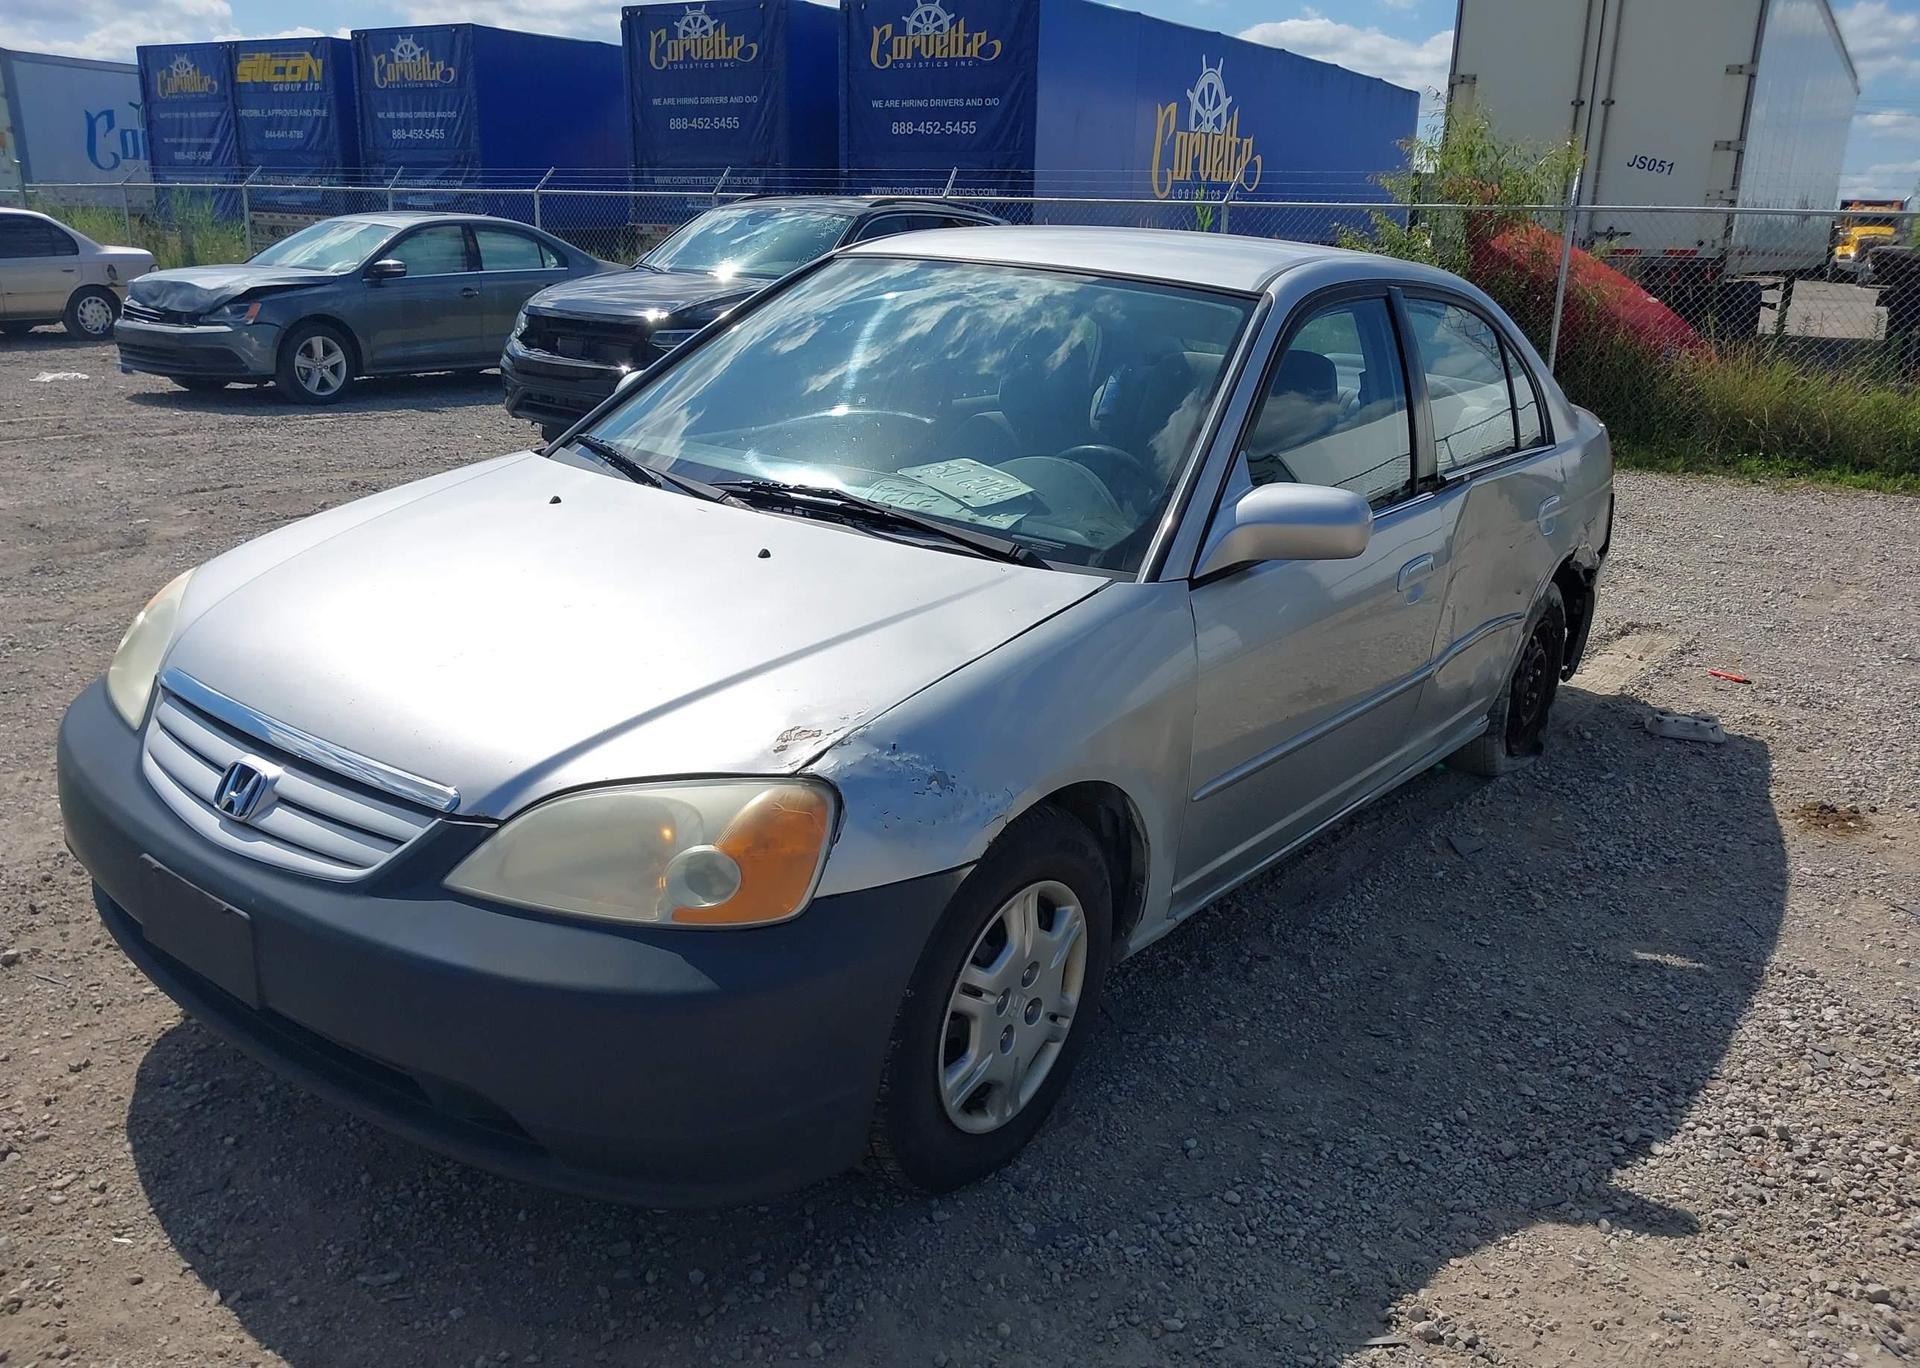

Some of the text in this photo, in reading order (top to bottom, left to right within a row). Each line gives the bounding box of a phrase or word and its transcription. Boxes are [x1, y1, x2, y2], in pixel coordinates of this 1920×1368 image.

[650, 22, 758, 70] Corvette
[870, 16, 1002, 69] Corvette
[373, 49, 455, 89] Corvette
[667, 62, 714, 70] LOGISTICS
[892, 60, 949, 69] LOGISTICS
[273, 83, 322, 92] GROUP LTD.
[652, 97, 662, 105] WE
[662, 97, 677, 105] ARE
[677, 97, 699, 105] HIRING
[700, 96, 729, 104] DRIVERS
[729, 96, 744, 104] AND
[871, 97, 1000, 108] WE ARE HIRING DRIVERS AND O/O
[669, 117, 740, 130] 888-452-5455
[891, 121, 977, 135] 888-452-5455
[391, 128, 445, 140] 888-452-5455
[1152, 102, 1262, 200] Corvette
[1626, 154, 1675, 176] JS051
[870, 186, 998, 196] WWW.CORVETTELOISTICS.COM
